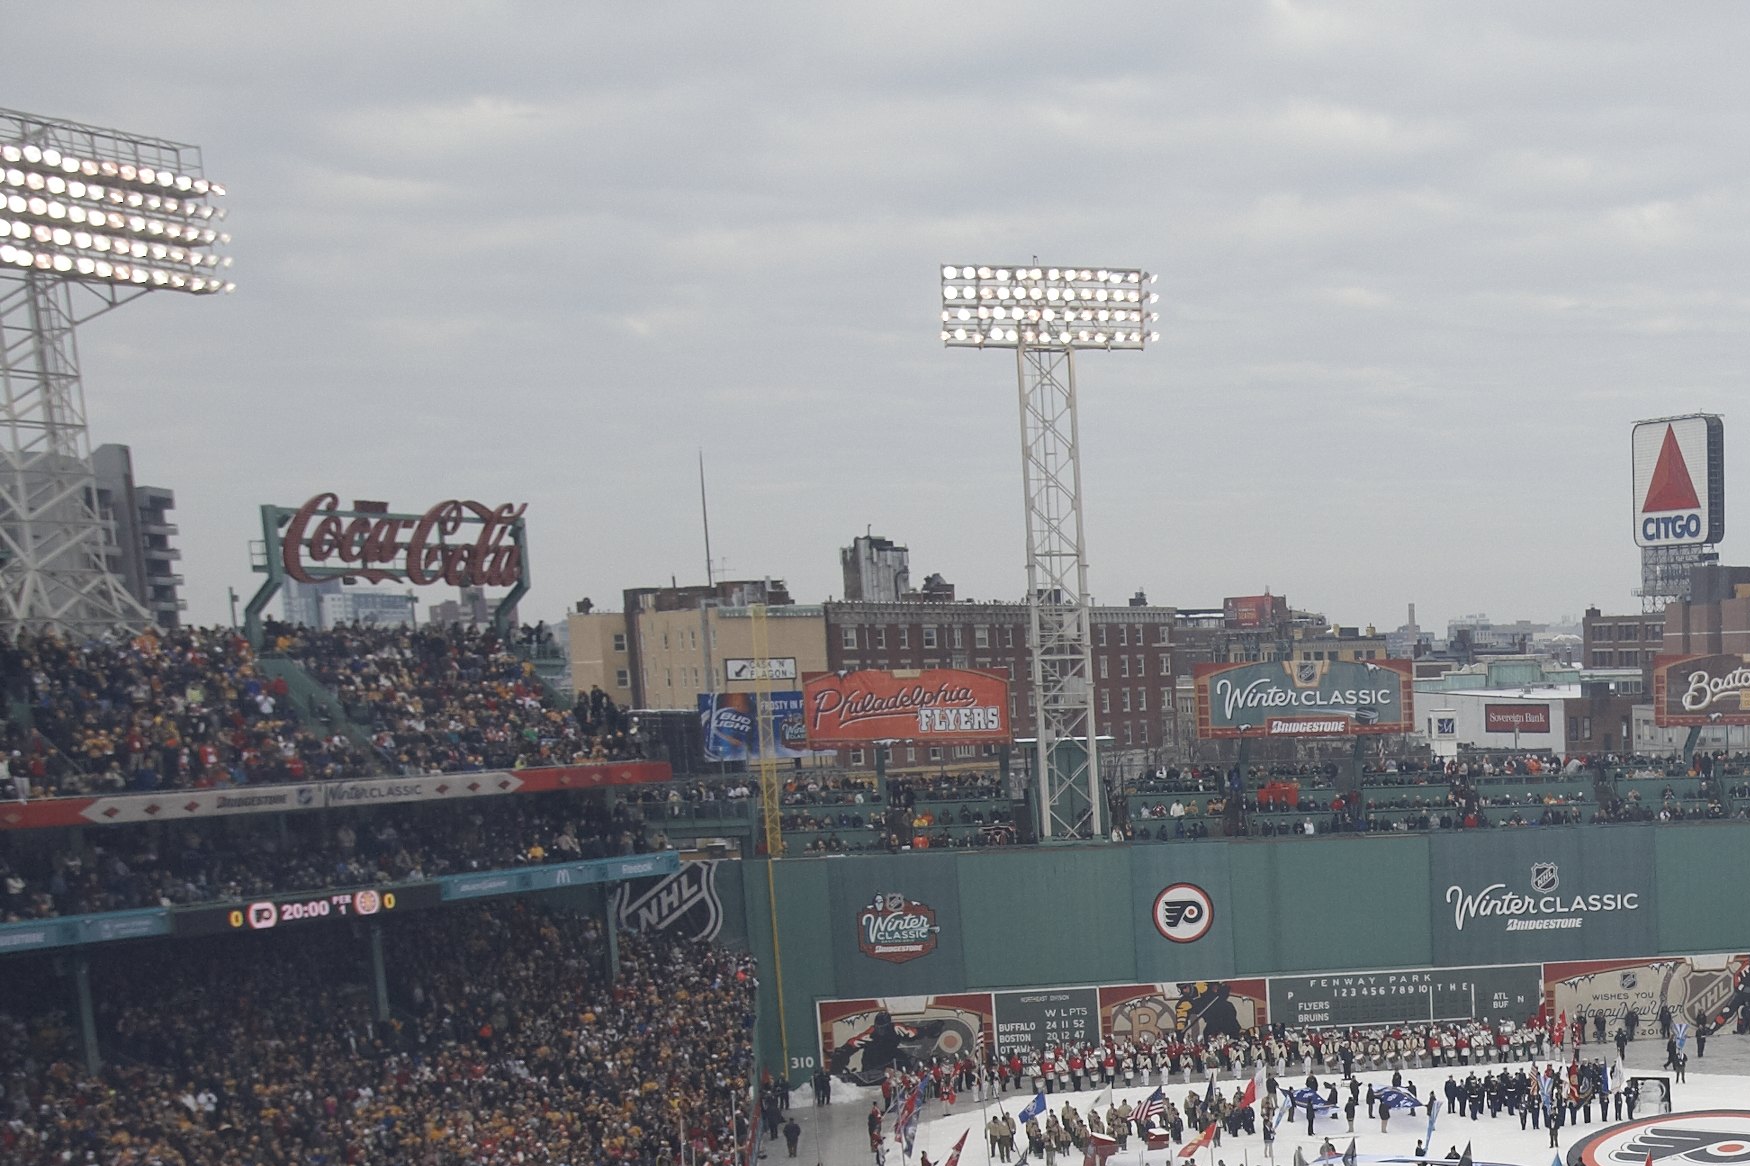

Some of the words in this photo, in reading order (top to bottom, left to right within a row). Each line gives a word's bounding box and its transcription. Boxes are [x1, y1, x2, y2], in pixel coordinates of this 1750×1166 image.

[1642, 513, 1701, 541] CITGO
[283, 492, 528, 587] Coca-Cola
[814, 682, 978, 731] Philadelphia
[1216, 679, 1301, 719] Winter
[1301, 688, 1391, 706] CLASSIC
[720, 712, 752, 724] BUD
[918, 705, 1001, 733] FLYERS
[1489, 711, 1523, 723] Sovereign
[1525, 712, 1546, 723] Bank
[1271, 720, 1346, 734] BRIDGESTONE
[1537, 868, 1554, 887] NHL
[281, 900, 330, 922] 20:00
[638, 873, 698, 932] NHL
[1446, 884, 1538, 931] Winter
[1539, 893, 1639, 914] CLASSIC
[862, 911, 929, 943] Winter
[1506, 917, 1583, 931] BRIDGESTONE
[876, 931, 928, 940] CLASSIC
[1310, 976, 1376, 988] FENWAY
[1389, 973, 1431, 984] PARK
[1341, 989, 1347, 997] 2
[1350, 988, 1356, 996] 3
[1362, 987, 1368, 996] 4
[1370, 987, 1377, 996] 5
[1379, 986, 1385, 995] 6
[1391, 986, 1397, 994] 7
[1399, 985, 1406, 994] 8
[1408, 985, 1414, 993] 9
[1418, 984, 1428, 993] 10
[1592, 992, 1629, 1000] WISHES
[1298, 1001, 1330, 1011] FLYERS
[1494, 992, 1509, 1001] ATL
[1045, 1009, 1056, 1017] W
[1061, 1009, 1067, 1017] L
[1069, 1007, 1088, 1016] PTS
[1298, 1013, 1329, 1022] BRUINS
[1493, 1000, 1509, 1009] BUF
[999, 1022, 1036, 1032] BUFFALO
[1046, 1021, 1057, 1029] 24
[1061, 1020, 1068, 1028] 11
[1073, 1019, 1085, 1028] 52
[999, 1033, 1031, 1043] BOSTON
[1046, 1032, 1058, 1040] 20
[1061, 1031, 1070, 1039] 12
[1074, 1030, 1085, 1039] 47
[791, 1057, 814, 1069] 310
